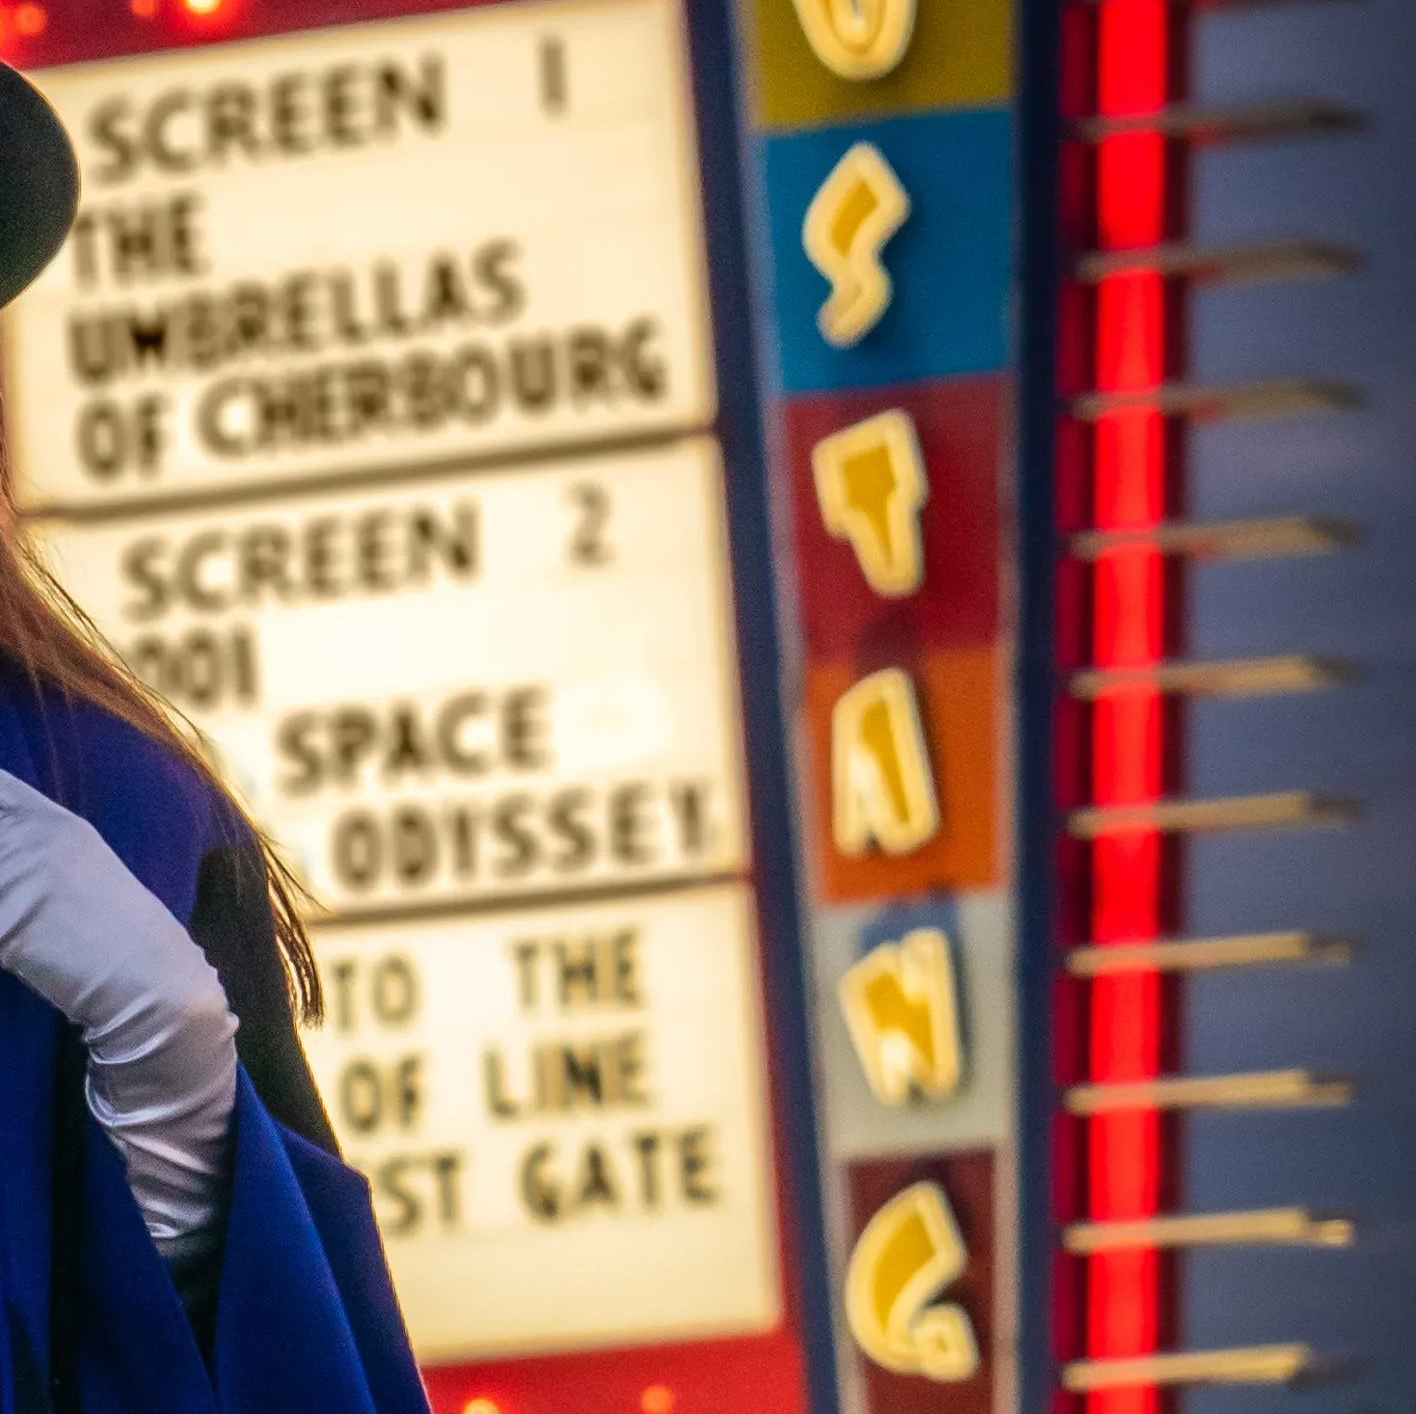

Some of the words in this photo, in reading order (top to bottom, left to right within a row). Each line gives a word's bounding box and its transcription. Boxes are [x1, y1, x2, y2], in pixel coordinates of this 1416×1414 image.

[86, 51, 446, 185] SCREEN
[537, 33, 568, 117] 1
[68, 191, 206, 289] THE
[76, 393, 172, 485] OF
[194, 317, 668, 461] CHERBOURG
[122, 499, 480, 621] SCREEN
[566, 483, 611, 570] 2
[274, 685, 552, 793] SPACE
[330, 953, 422, 1035] TO
[508, 925, 644, 1011] THE
[340, 1053, 424, 1135] OF
[482, 1029, 646, 1121] LINE
[519, 1125, 722, 1227] GATE
